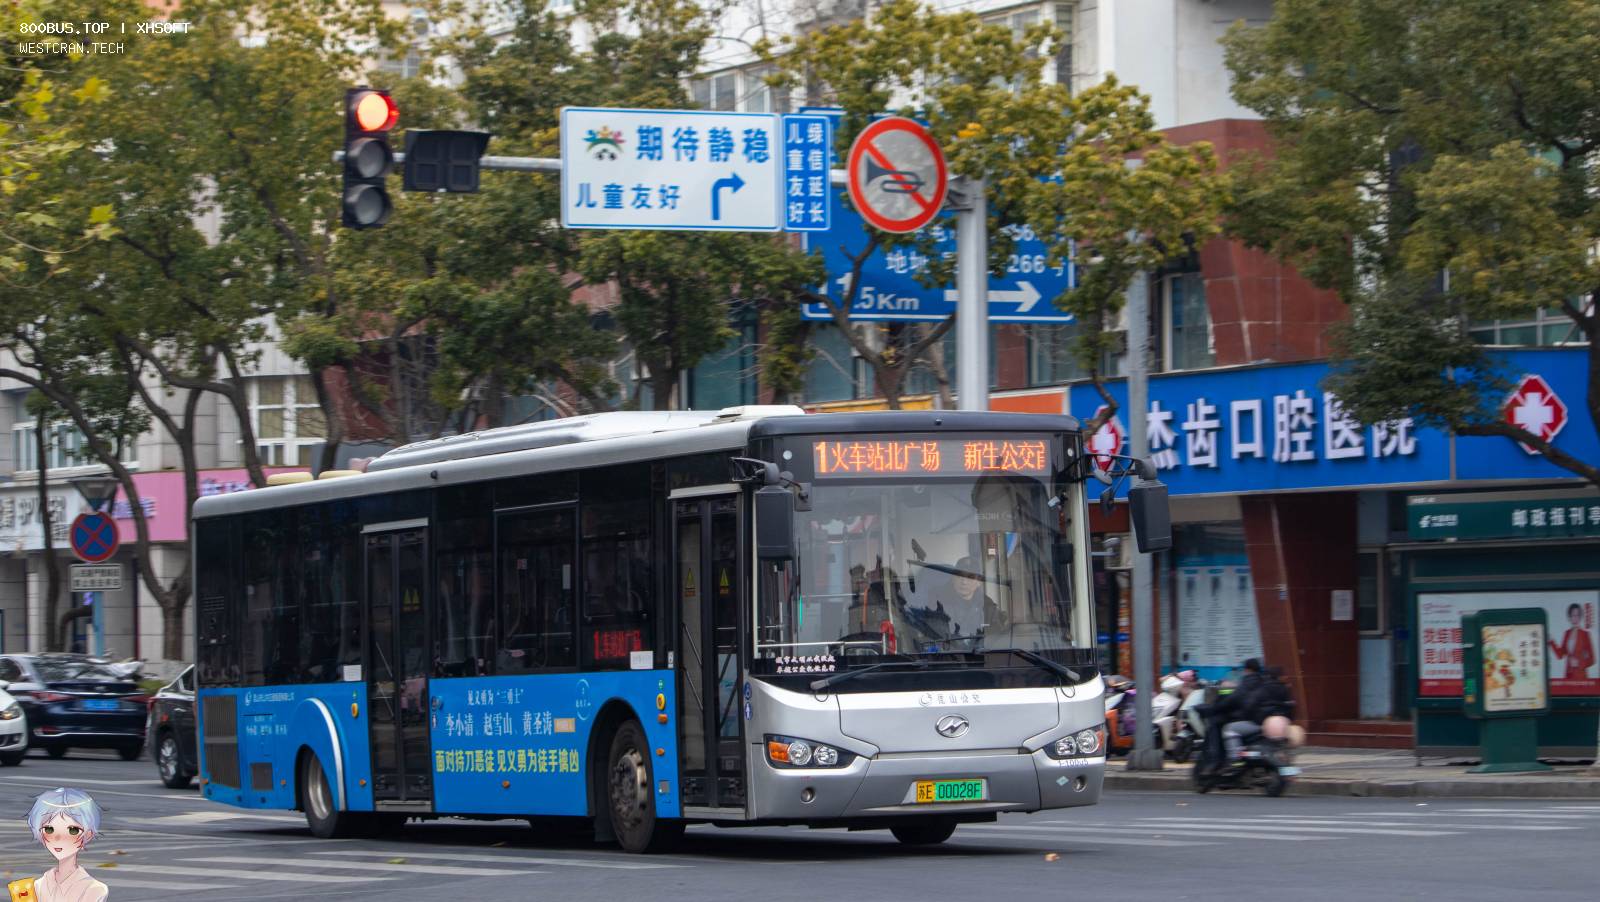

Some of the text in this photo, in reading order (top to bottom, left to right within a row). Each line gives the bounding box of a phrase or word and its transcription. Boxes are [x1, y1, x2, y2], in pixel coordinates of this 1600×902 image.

[636, 125, 770, 163] 期待静稳
[786, 123, 806, 223] 儿童友好
[807, 122, 825, 223] 绿信延长
[575, 182, 681, 210] 儿童友好
[1145, 389, 1417, 471] 杰齿口腔医院
[435, 750, 495, 773] 面对持刀恶徒
[938, 782, 981, 799] 00028F
